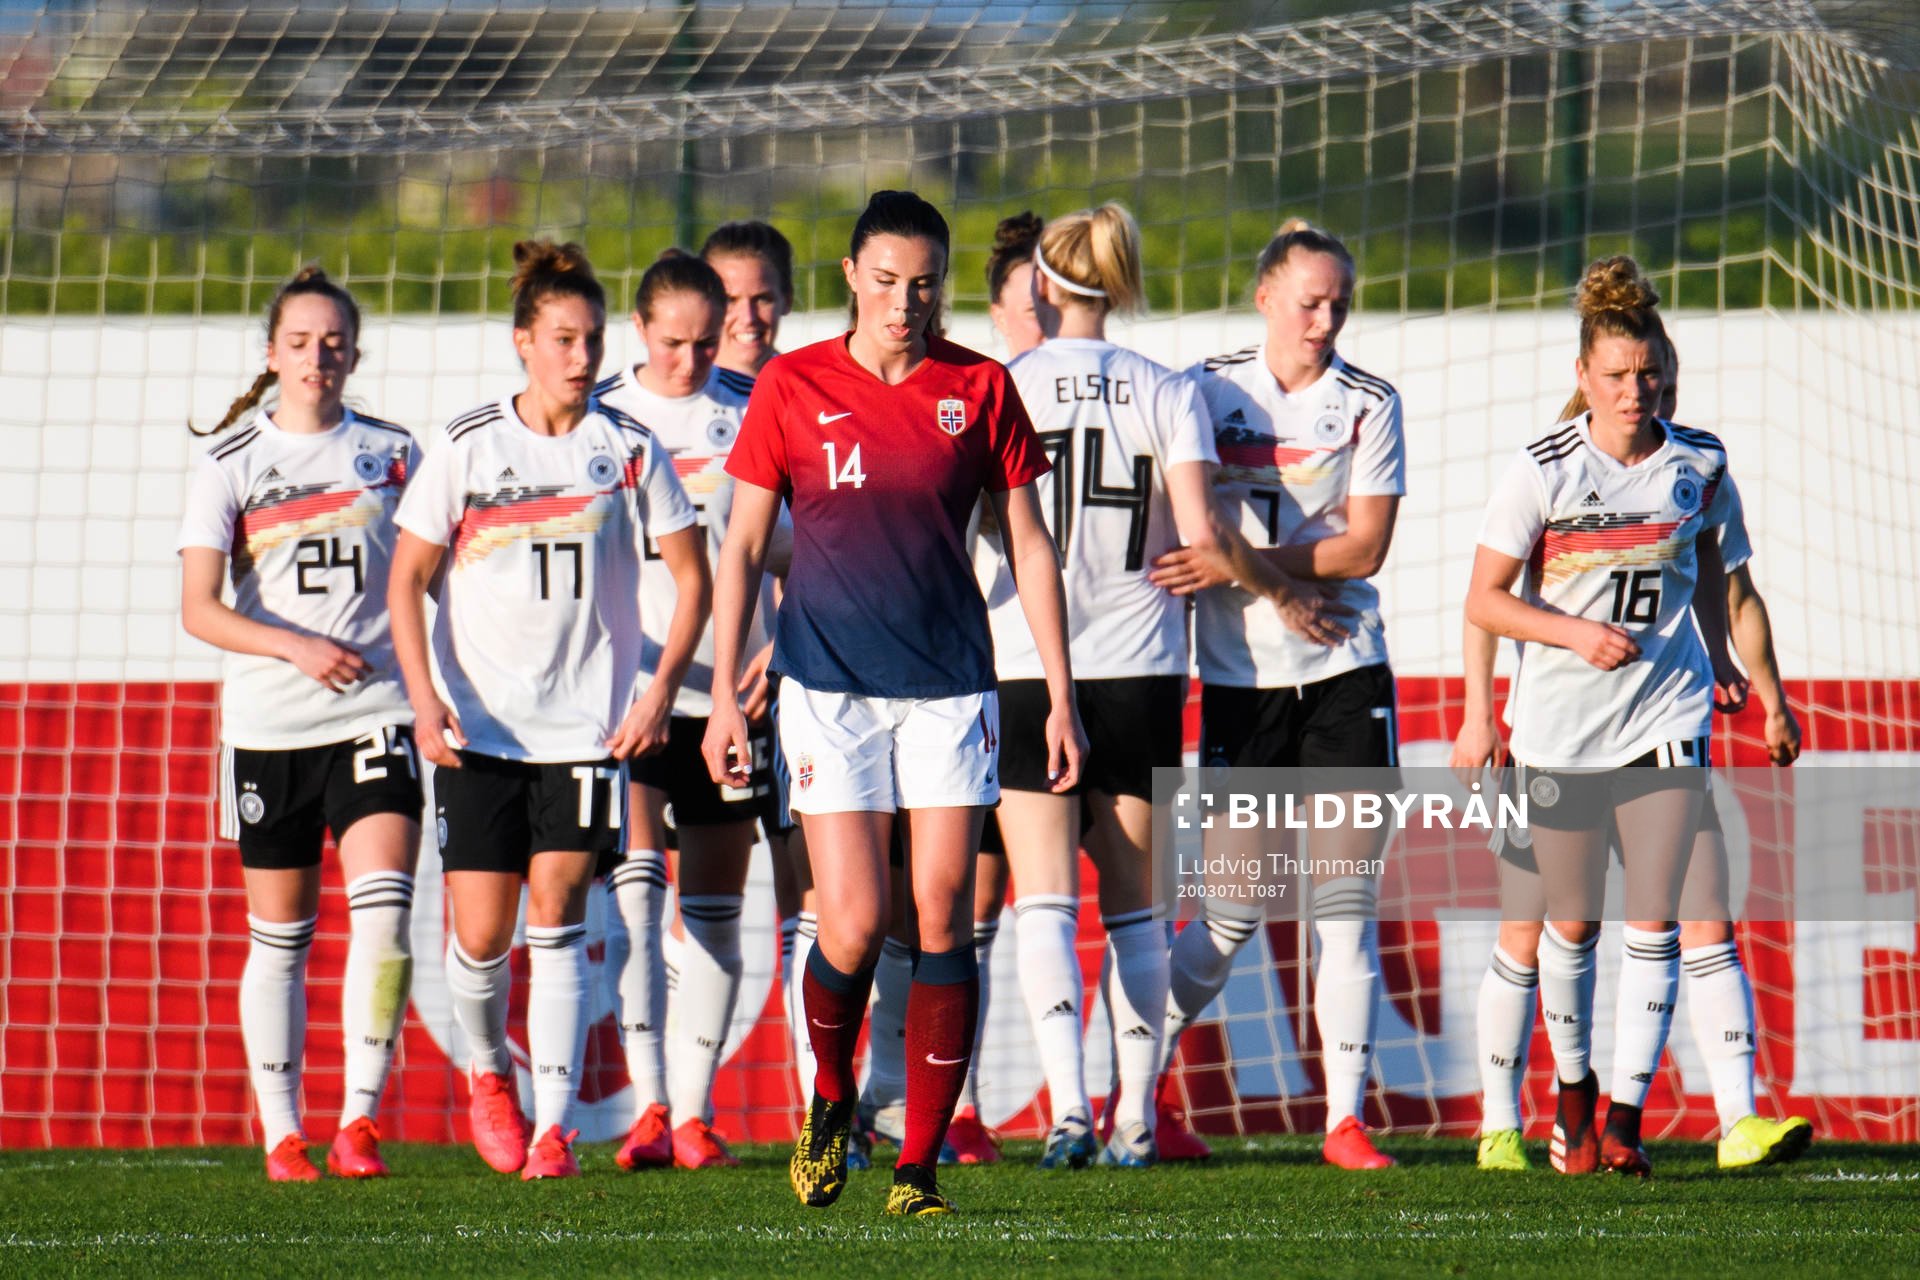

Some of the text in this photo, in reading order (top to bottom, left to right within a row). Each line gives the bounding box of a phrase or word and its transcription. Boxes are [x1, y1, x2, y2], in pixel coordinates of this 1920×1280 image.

[821, 441, 867, 490] 14
[1036, 426, 1153, 571] 14
[1250, 488, 1280, 545] 7
[297, 537, 363, 595] 24
[531, 542, 582, 600] 17
[1609, 569, 1662, 624] 16
[571, 766, 622, 829] 17
